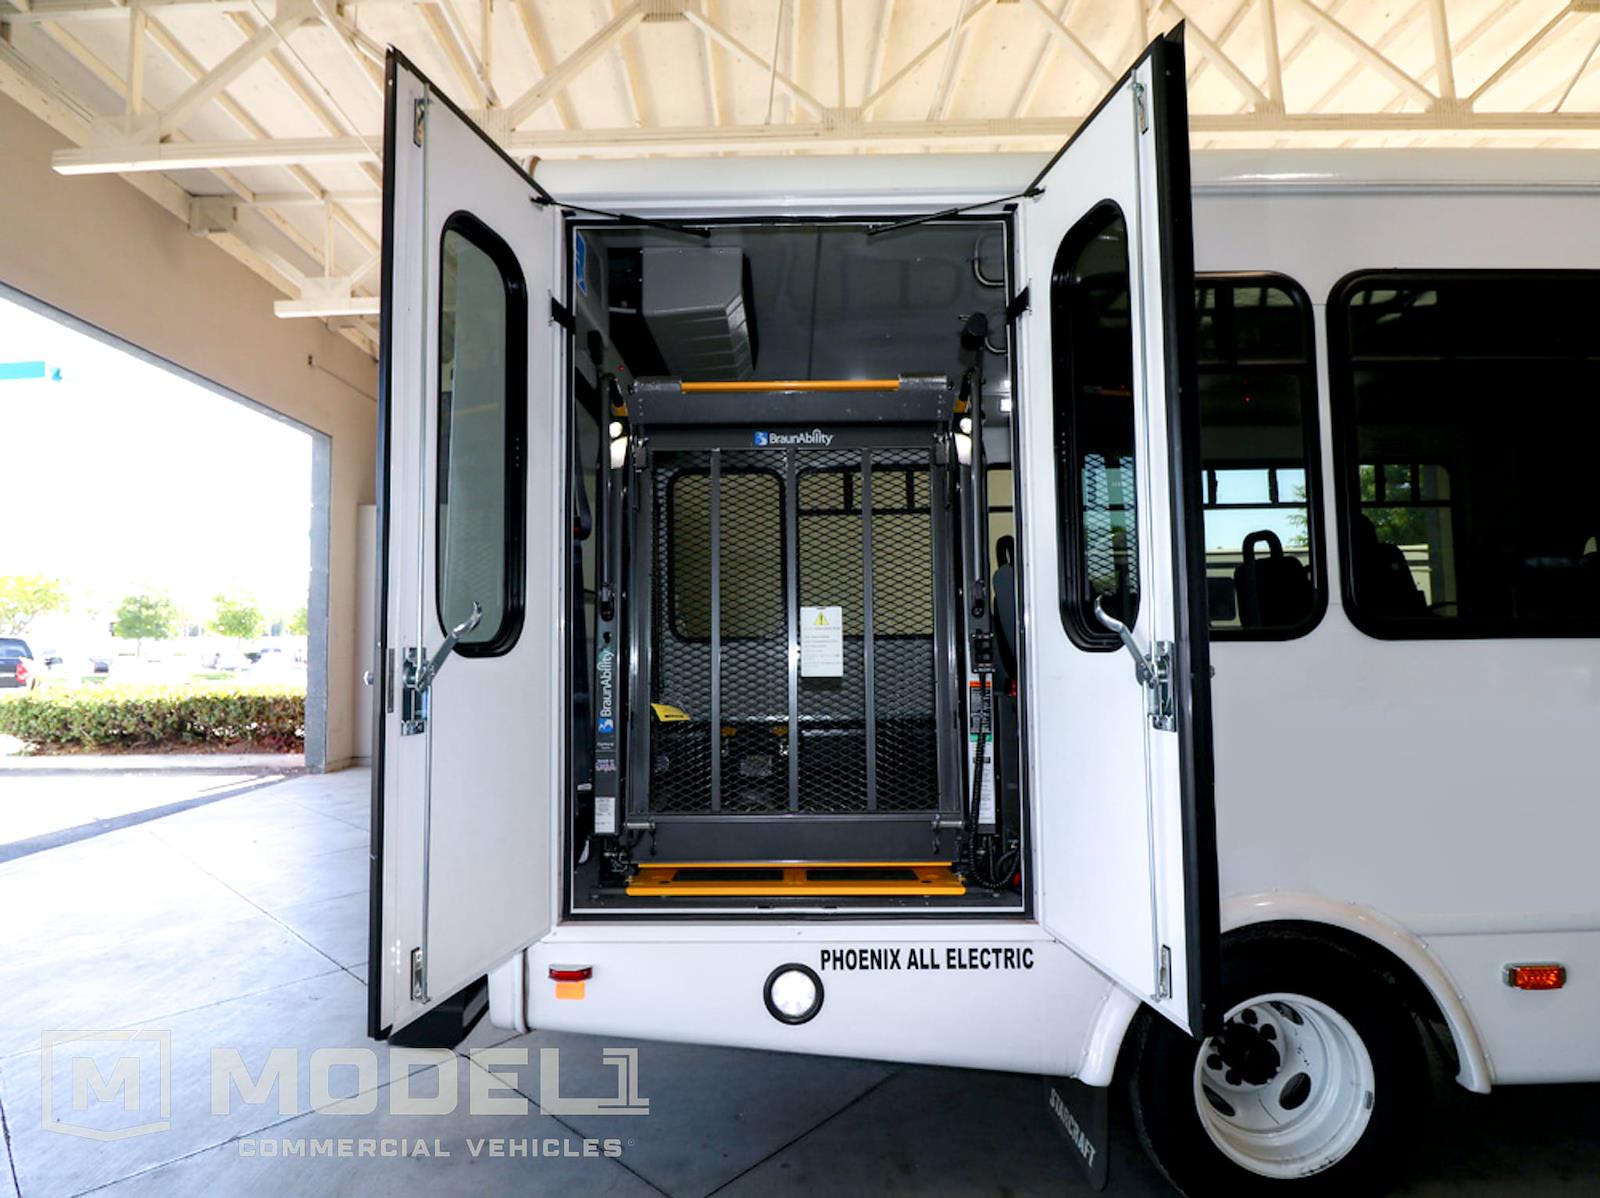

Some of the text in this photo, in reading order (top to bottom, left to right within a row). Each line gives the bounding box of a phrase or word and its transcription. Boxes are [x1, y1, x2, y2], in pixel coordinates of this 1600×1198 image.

[769, 428, 834, 446] BraunAbility
[597, 650, 616, 718] BraunAbility
[820, 947, 1035, 971] PHOENIX ALL ELECTRIC
[1049, 1087, 1096, 1168] STARCRAFT
